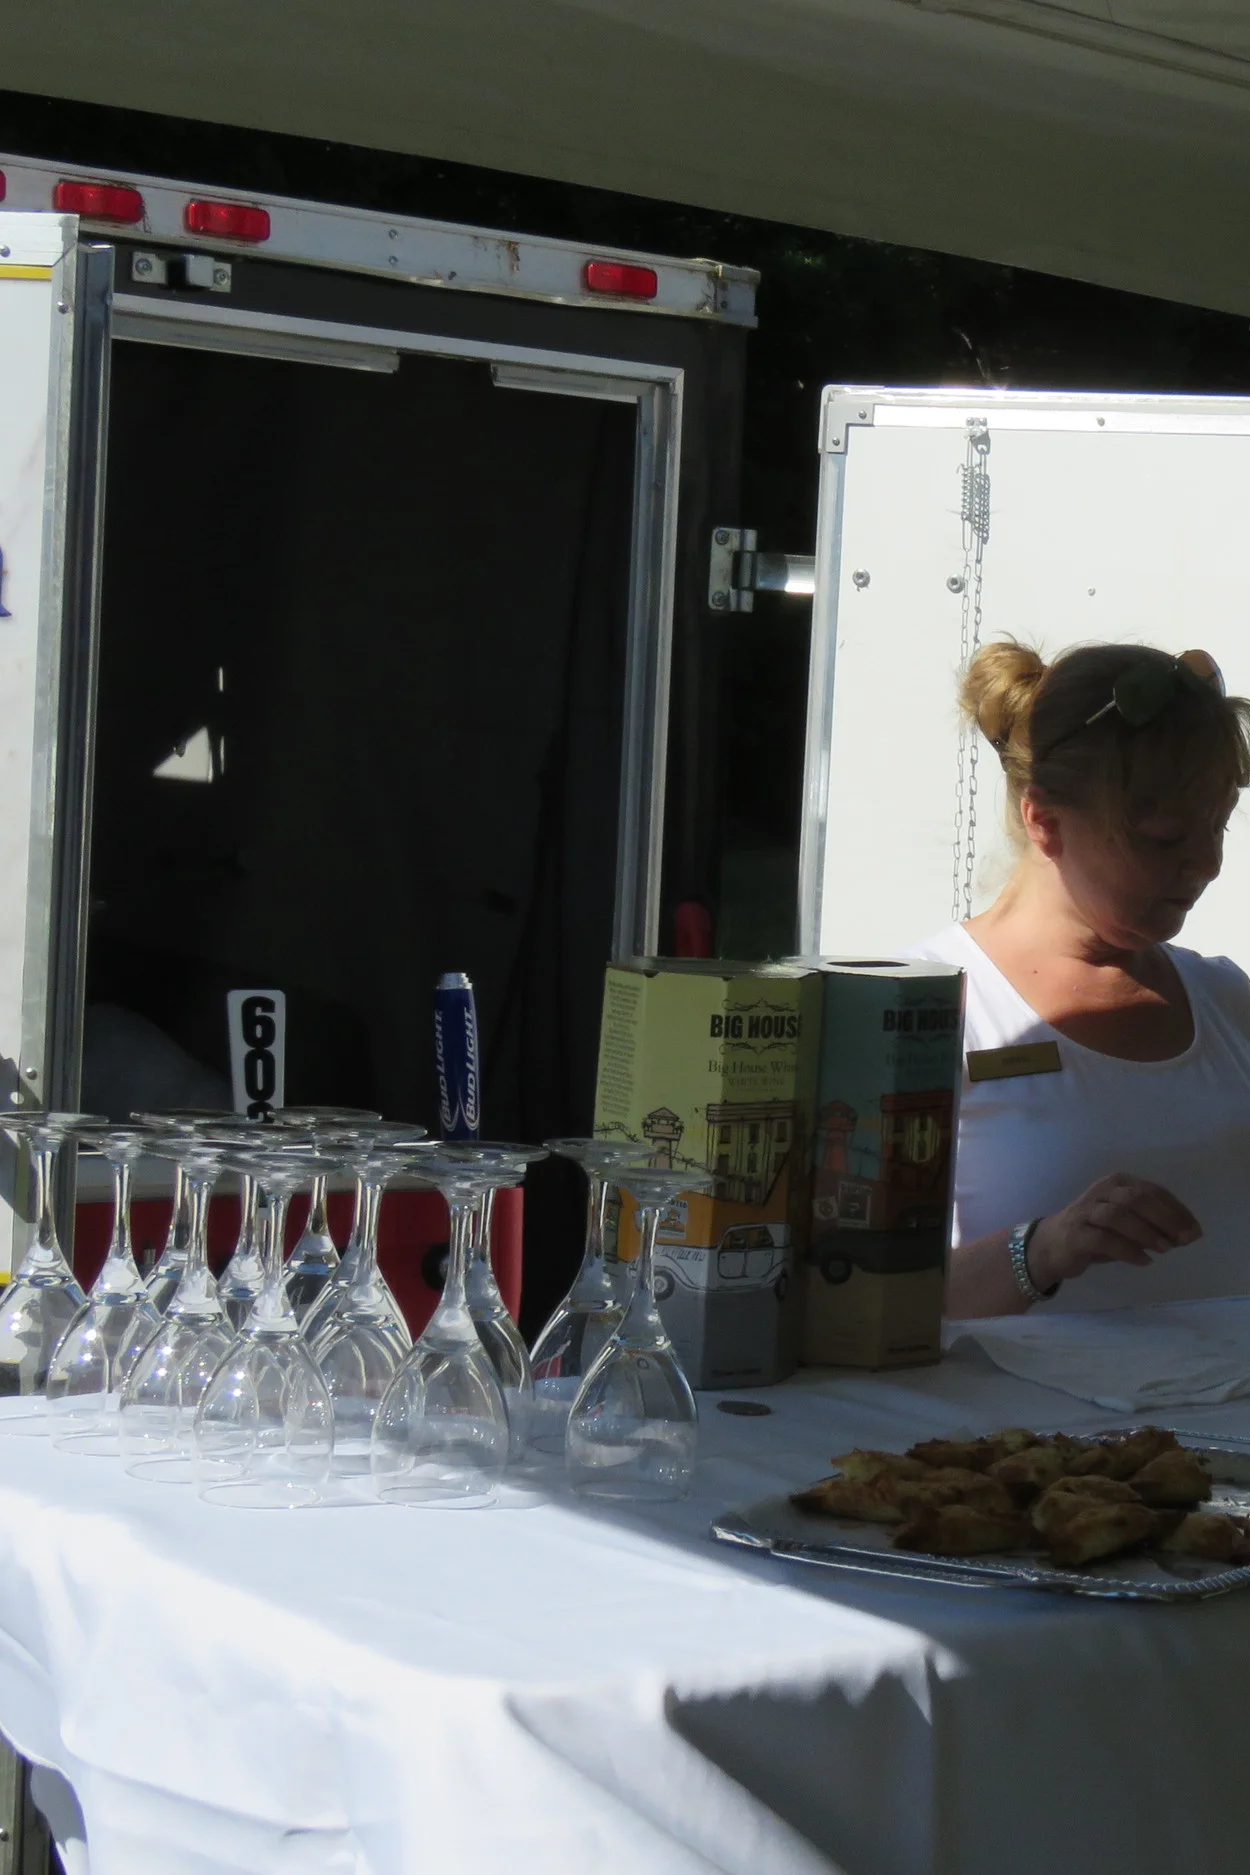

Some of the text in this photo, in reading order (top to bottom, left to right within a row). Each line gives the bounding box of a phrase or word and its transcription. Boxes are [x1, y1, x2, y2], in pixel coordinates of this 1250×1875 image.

[710, 1014, 743, 1038] BIG
[883, 1008, 961, 1033] BIG HOUS
[434, 1008, 452, 1122] BUD LIGHT
[464, 1006, 476, 1120] BUD LIGHT
[708, 1059, 729, 1077] Big
[732, 1060, 768, 1074] House
